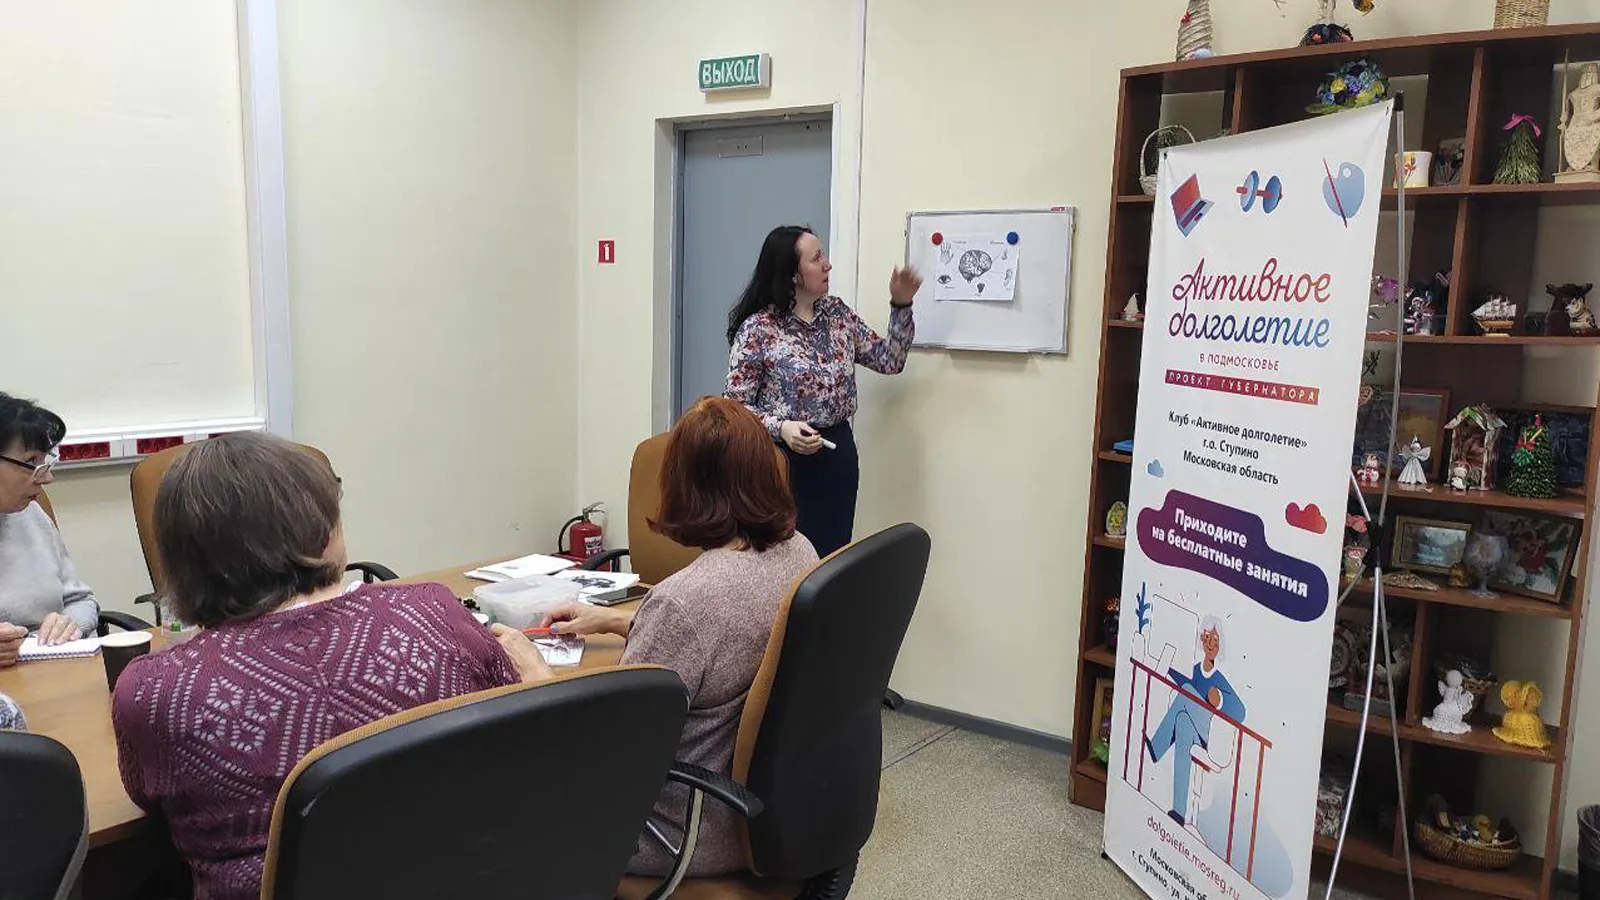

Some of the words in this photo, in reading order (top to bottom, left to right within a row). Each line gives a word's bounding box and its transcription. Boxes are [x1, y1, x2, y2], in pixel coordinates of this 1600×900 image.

[702, 58, 756, 85] ВЫХОД
[1172, 257, 1331, 303] Активное
[1169, 297, 1330, 348] долголетие
[1208, 354, 1279, 371] ПОДМОСКОВЬЕ
[1169, 371, 1211, 387] ПРОЕКТ
[1221, 379, 1314, 401] ГУБЕРНАТОРА
[1168, 411, 1189, 427] Клуб
[1191, 416, 1240, 436] «Активное
[1241, 427, 1308, 449] долголетие»
[1202, 438, 1217, 450] г.о.
[1219, 440, 1259, 460] Ступино
[1183, 450, 1237, 475] Московская
[1239, 465, 1279, 485] область
[1174, 508, 1248, 549] Приходите
[1152, 526, 1165, 542] на
[1167, 528, 1243, 573] бесплатные
[1246, 561, 1308, 598] занятия
[1149, 847, 1195, 895] Московская
